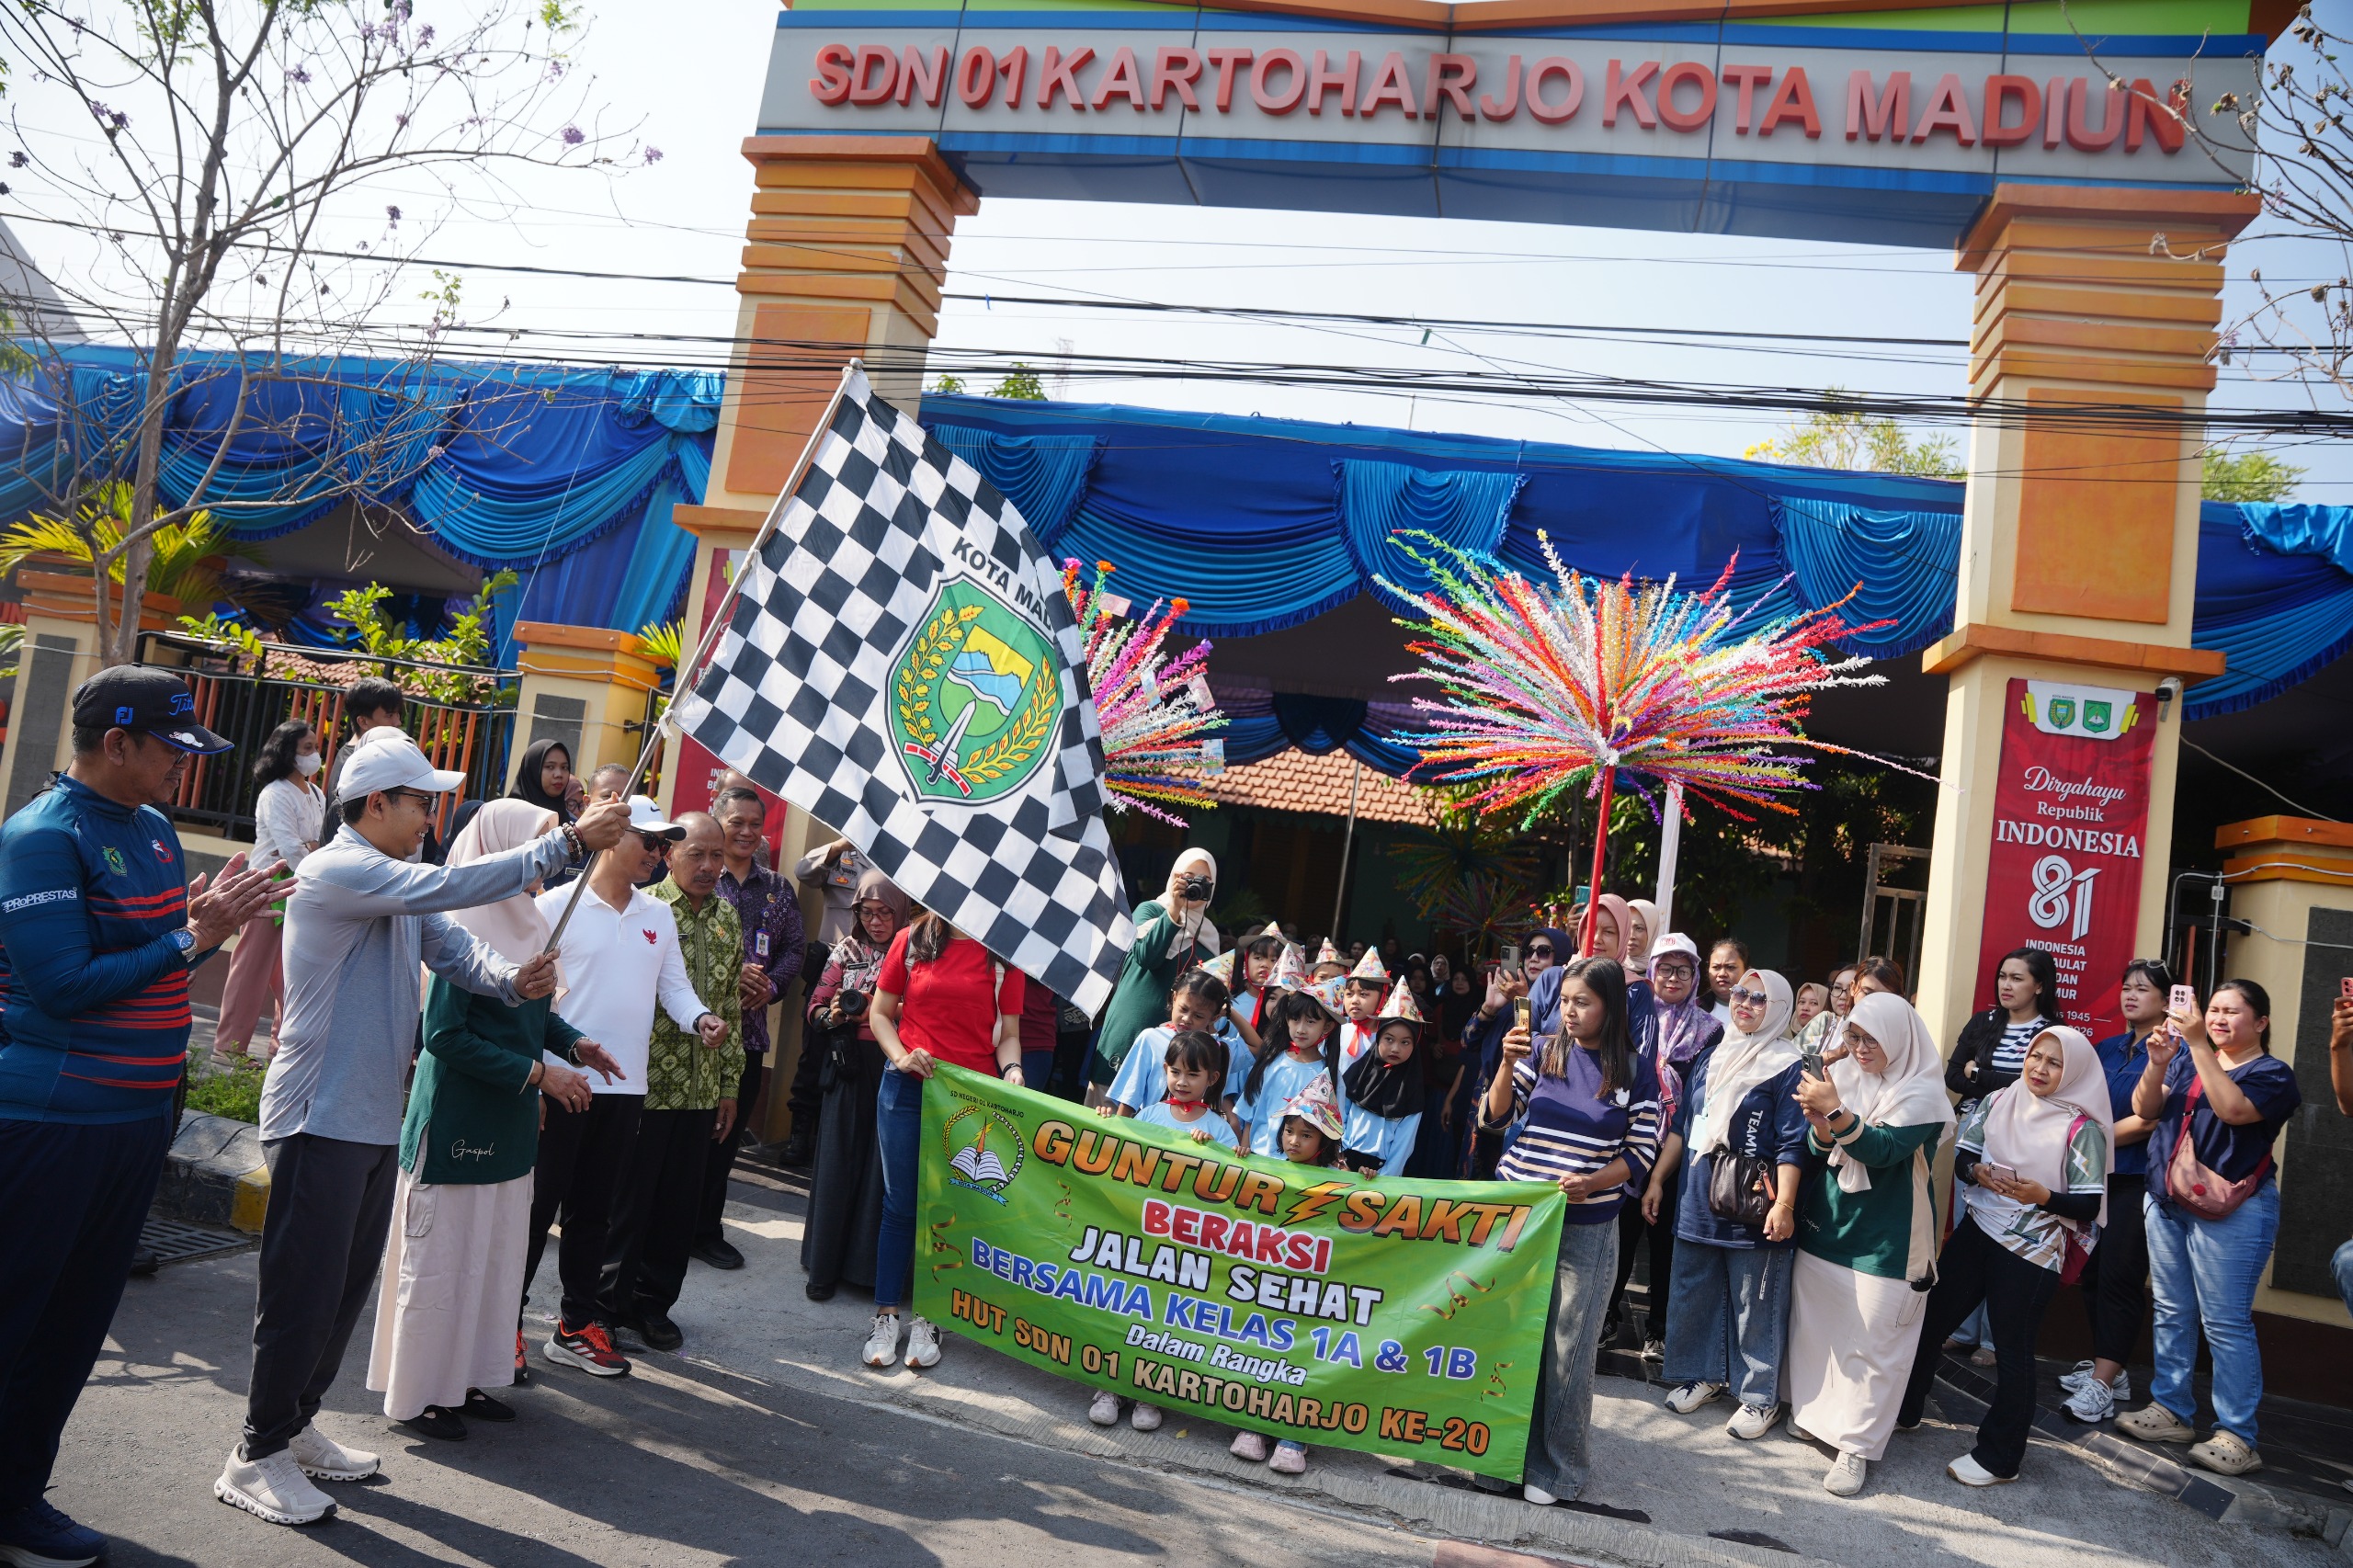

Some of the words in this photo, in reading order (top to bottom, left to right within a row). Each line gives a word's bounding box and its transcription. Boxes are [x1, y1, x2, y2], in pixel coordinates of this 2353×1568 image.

[809, 43, 949, 108] SDN
[956, 45, 1027, 109] 01
[1036, 46, 1585, 125] KARTOHARJO
[1602, 59, 1823, 139] KOTA
[1846, 70, 2191, 154] MADIUN
[951, 535, 1010, 594] KOTA
[1014, 583, 1051, 631] MAD
[116, 707, 133, 724] FJ
[2024, 766, 2126, 807] Dirgahayu
[2037, 801, 2104, 823] Republik
[1996, 820, 2141, 858] INDONESIA
[2029, 855, 2102, 942] 81
[2026, 939, 2086, 956] INDONESIA
[2053, 958, 2087, 971] AULAT
[2055, 988, 2076, 1000] MUR
[2067, 1010, 2090, 1022] 1945
[959, 1092, 978, 1104] NEGERI
[986, 1101, 1024, 1118] KARTOHARJO
[451, 1139, 494, 1161] Gaspol
[1745, 1110, 1764, 1158] TEAMW
[1031, 1119, 1285, 1217] GUNTUR
[1337, 1190, 1533, 1253] SAKTI
[1142, 1198, 1334, 1276] BERAKSI
[1068, 1224, 1212, 1292] JALAN
[1226, 1265, 1383, 1328] SEHAT
[971, 1237, 1154, 1321] BERSAMA
[1164, 1292, 1299, 1353] KELAS
[1310, 1325, 1363, 1369] 1A
[1374, 1338, 1408, 1374] &
[1424, 1345, 1478, 1381] 1B
[951, 1288, 1007, 1335] HUT
[1014, 1316, 1073, 1366] SDN
[1081, 1346, 1120, 1381] 01
[1133, 1358, 1370, 1434] KARTOHARJO
[1379, 1407, 1491, 1458] KE-20
[1124, 1324, 1207, 1364] Dalam
[1210, 1343, 1309, 1388] Rangka
